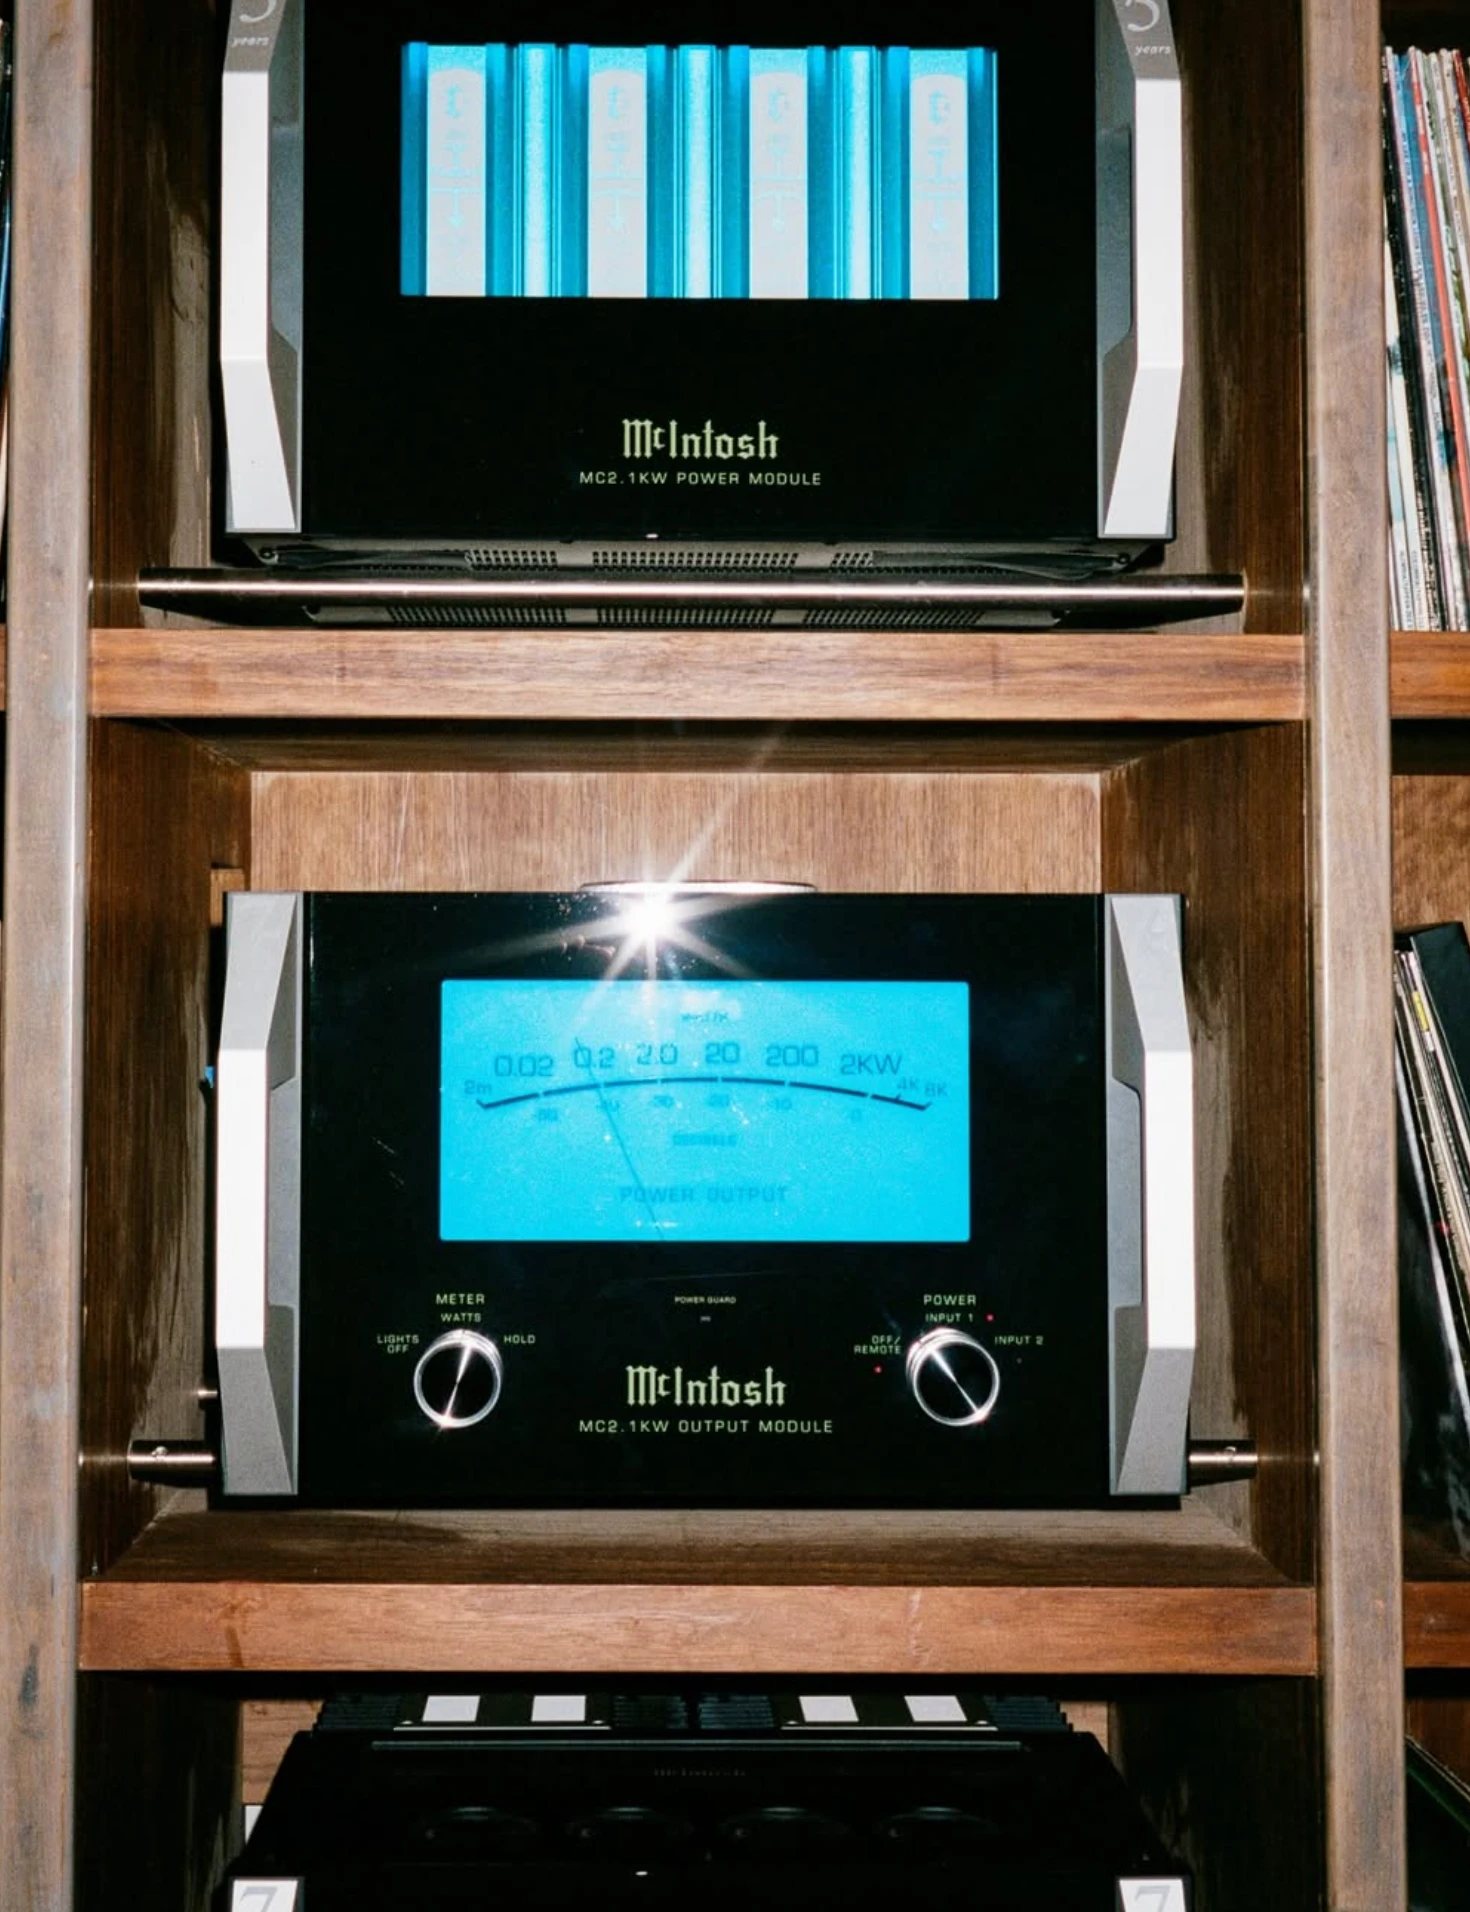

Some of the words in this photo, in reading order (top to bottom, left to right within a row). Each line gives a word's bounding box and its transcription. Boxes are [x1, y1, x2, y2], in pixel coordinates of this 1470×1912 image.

[1135, 46, 1171, 56] years
[622, 418, 779, 460] McIntosh
[579, 471, 668, 485] MC2.1KW
[676, 472, 740, 485] POWER
[748, 472, 821, 486] MODULE
[494, 1055, 554, 1077] 0.02
[573, 1046, 615, 1068] 0.2
[705, 1042, 740, 1064] 20
[765, 1045, 819, 1067] 200
[840, 1053, 902, 1076] 2KW
[619, 1187, 694, 1202] POWER
[706, 1186, 787, 1202] OUTPUT
[435, 1293, 485, 1306] METER
[674, 1295, 705, 1305] POWER
[708, 1295, 737, 1305] GUARD
[923, 1294, 977, 1306] POWER
[440, 1312, 482, 1323] WATTS
[925, 1312, 962, 1323] INPUT
[967, 1312, 974, 1323] 1
[377, 1334, 420, 1344] LIGHTS
[503, 1334, 536, 1345] HOLD
[994, 1335, 1029, 1346] INPUT
[1035, 1335, 1044, 1346] 2
[387, 1343, 409, 1354] OFF
[853, 1344, 902, 1355] REMOTE
[626, 1364, 787, 1407] McIntosh
[579, 1419, 670, 1434] MC2.1KW
[678, 1419, 749, 1434] OUTPUT
[758, 1419, 833, 1434] MODULE
